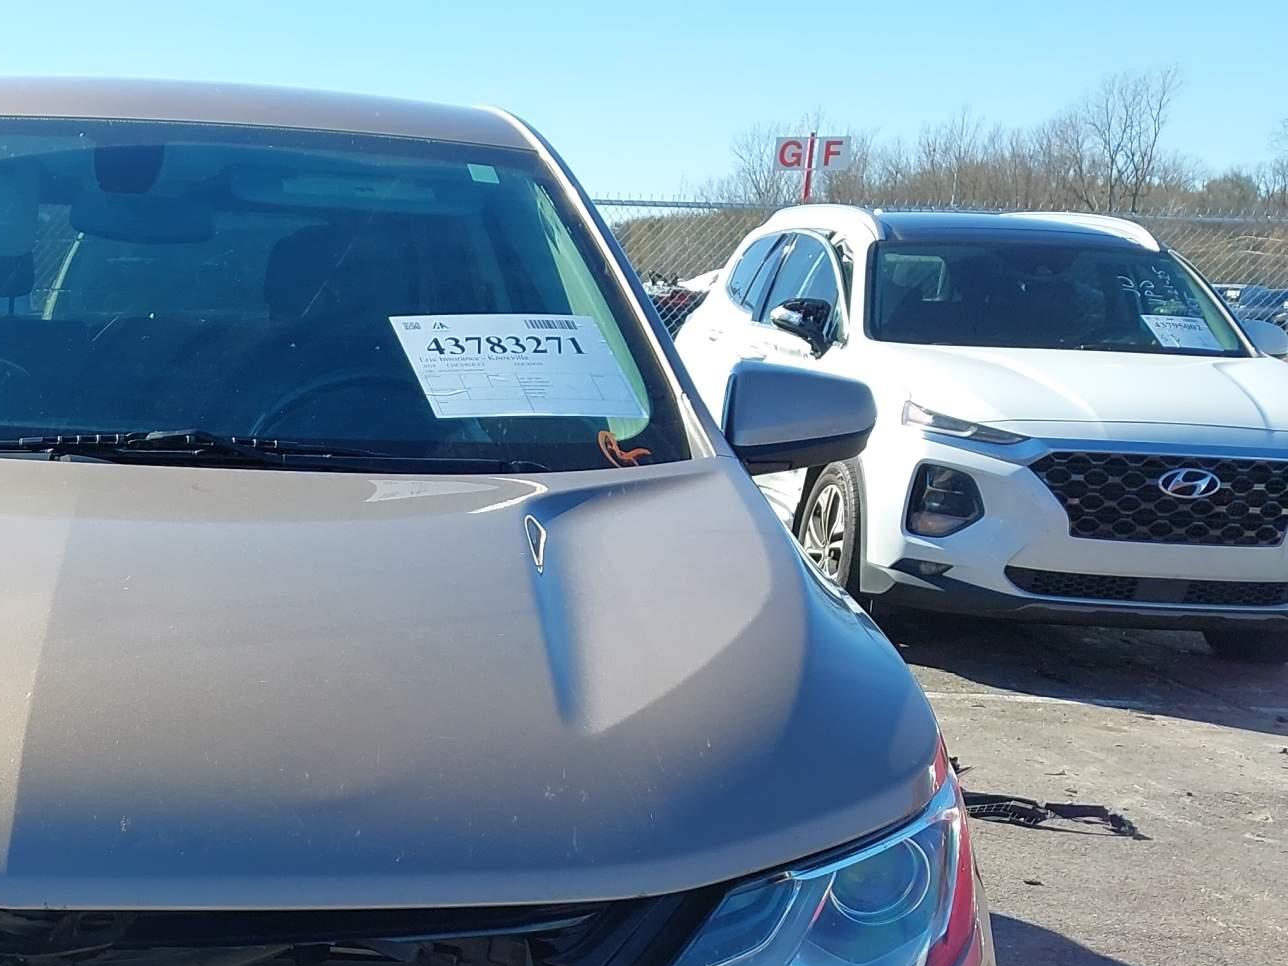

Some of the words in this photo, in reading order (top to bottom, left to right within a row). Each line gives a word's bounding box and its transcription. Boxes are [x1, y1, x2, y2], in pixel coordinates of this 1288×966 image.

[779, 140, 803, 167] G
[823, 140, 843, 166] F
[427, 336, 585, 355] 43783271
